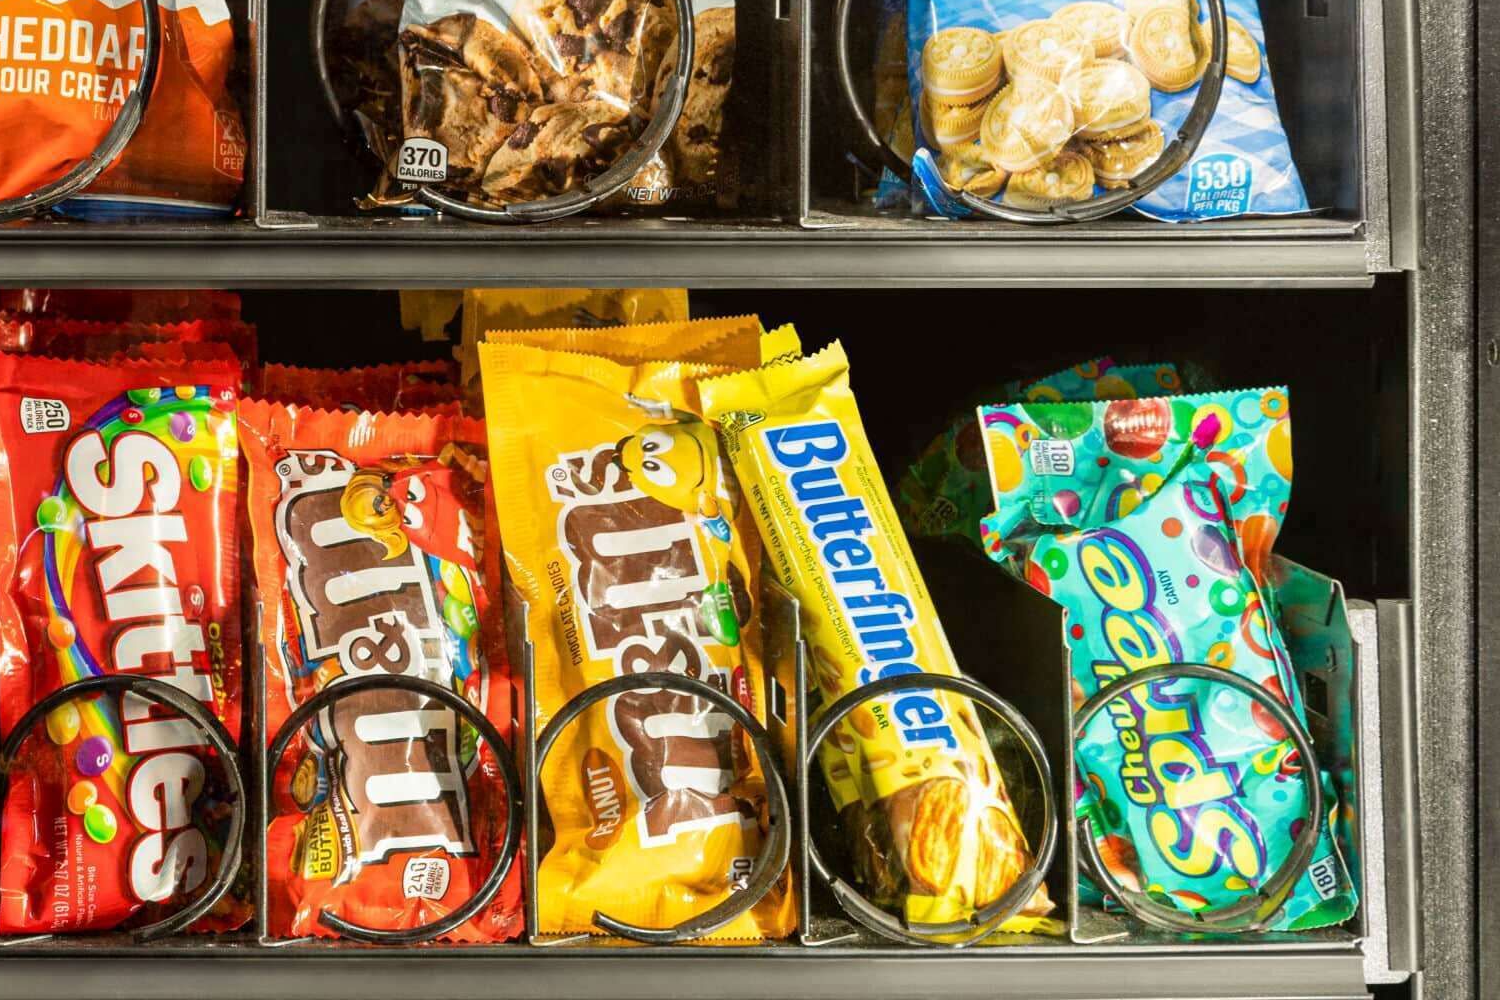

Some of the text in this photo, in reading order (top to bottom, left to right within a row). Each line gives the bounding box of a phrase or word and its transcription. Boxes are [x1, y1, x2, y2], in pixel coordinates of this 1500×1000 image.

[403, 146, 442, 168] 370
[399, 166, 446, 180] CALORIES
[402, 182, 419, 191] PER
[1197, 160, 1246, 190] 530
[627, 187, 656, 201] NET
[1192, 187, 1248, 204] CALORIES
[1216, 200, 1240, 213] PKG
[33, 399, 45, 431] CALORIES
[43, 400, 65, 429] 250
[1050, 445, 1070, 473] 180
[750, 483, 762, 501] NET
[758, 502, 770, 523] WT
[1156, 568, 1180, 606] CANDY
[546, 559, 584, 667] CHOCOLATE CANDIES
[66, 430, 214, 904] Skittles
[871, 705, 890, 730] BAR
[1092, 660, 1147, 807] Chewy
[587, 765, 621, 839] PEANUT
[54, 817, 68, 837] NET
[338, 812, 352, 836] Real
[75, 833, 86, 907] Natural & Artificial
[87, 865, 97, 903] Bite Size
[407, 861, 428, 894] 240
[424, 861, 439, 895] CALORIES
[1308, 864, 1337, 898] 180
[53, 884, 70, 898] OZ
